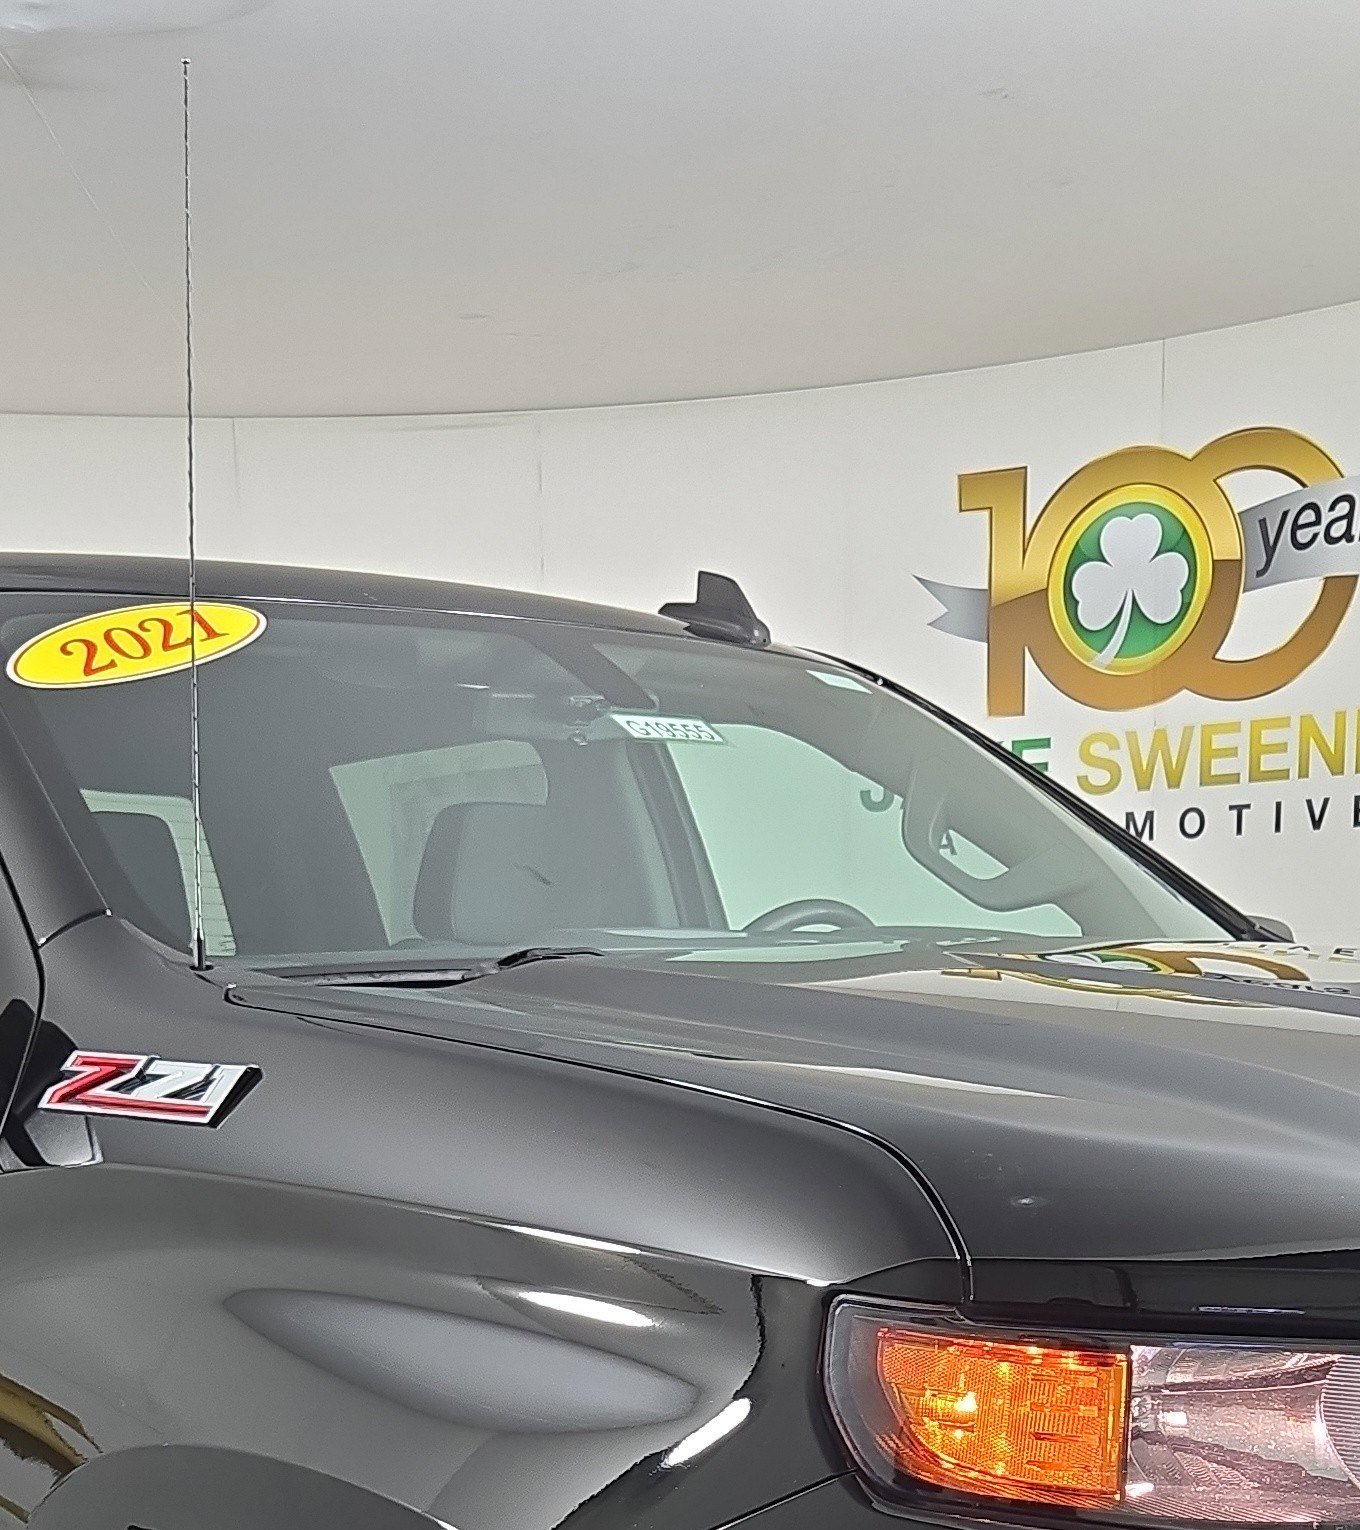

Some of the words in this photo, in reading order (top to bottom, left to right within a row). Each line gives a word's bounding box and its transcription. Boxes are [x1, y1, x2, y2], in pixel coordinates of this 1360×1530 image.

[958, 426, 1359, 717] 100
[60, 609, 229, 677] 2021
[38, 1049, 254, 1126] Z71
